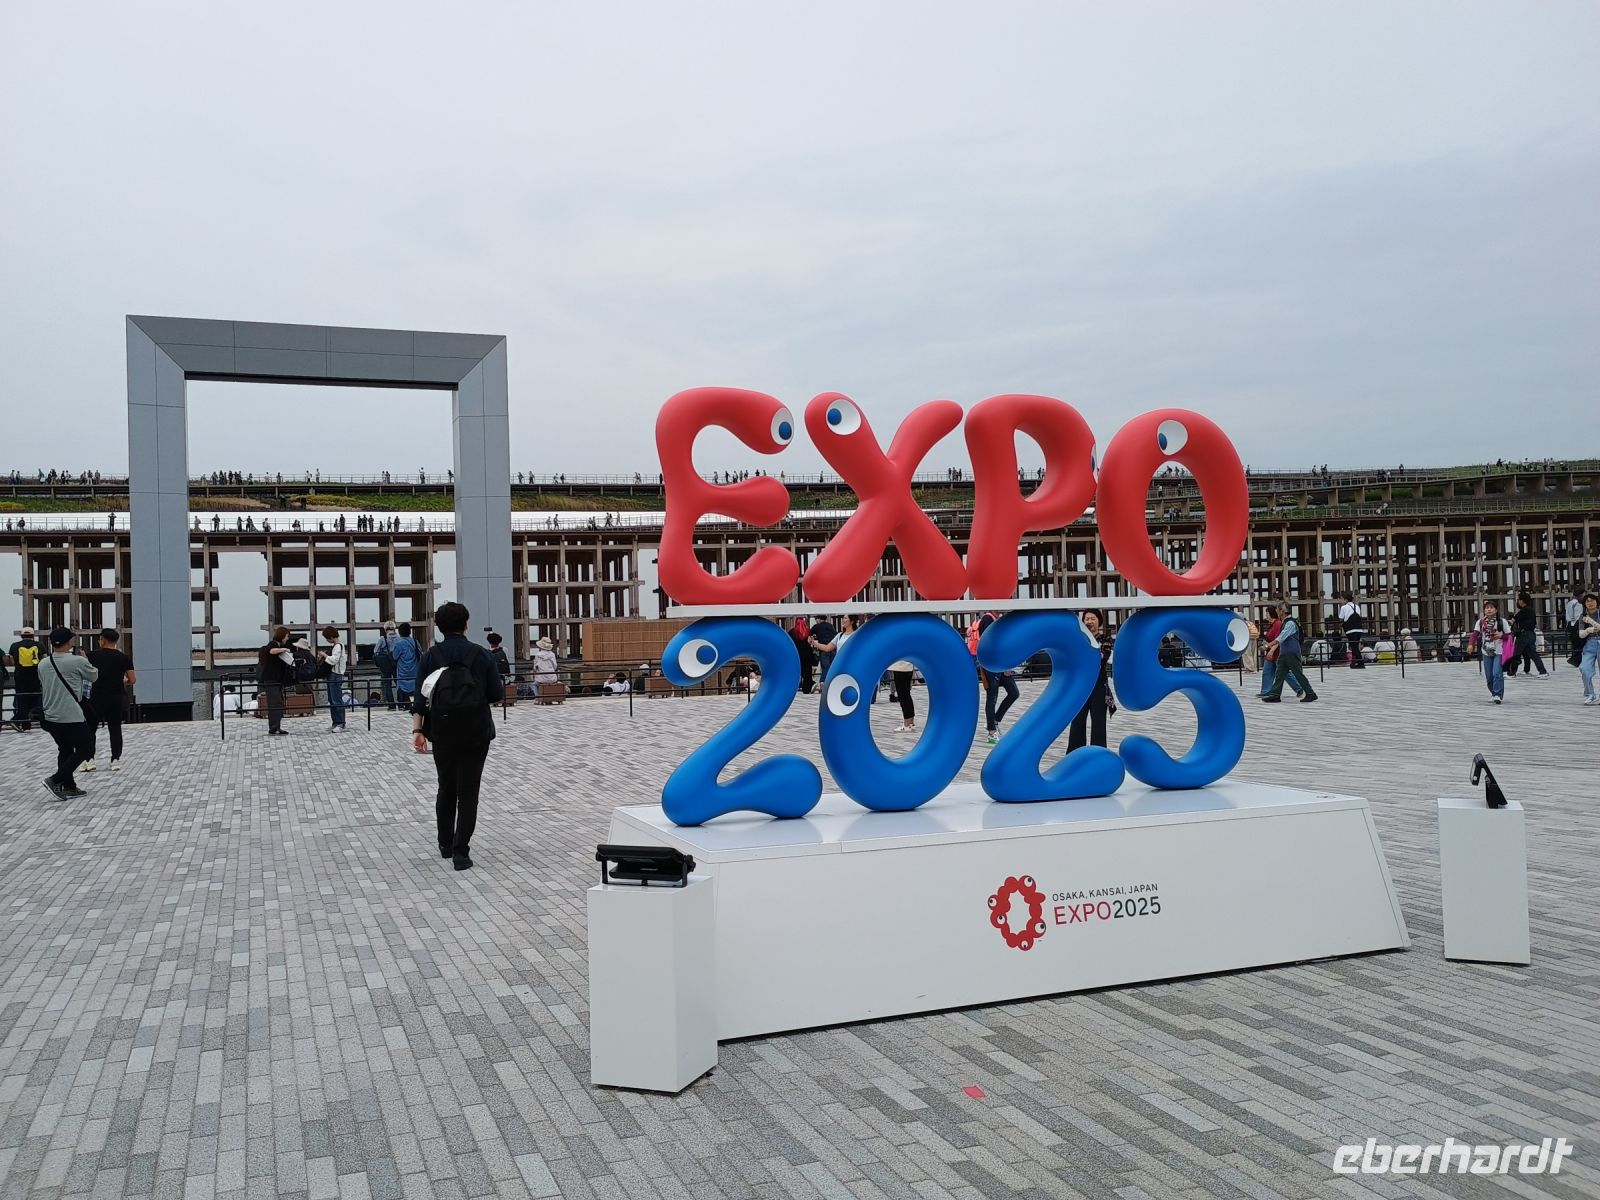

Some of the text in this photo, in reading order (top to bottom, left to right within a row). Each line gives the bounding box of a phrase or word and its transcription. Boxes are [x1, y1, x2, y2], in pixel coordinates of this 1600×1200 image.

[655, 387, 1249, 603] EXPO
[662, 607, 1250, 826] 2025
[1052, 883, 1158, 902] OSAKA, KANSAI, JAPAN
[1054, 896, 1161, 925] EXPO2025
